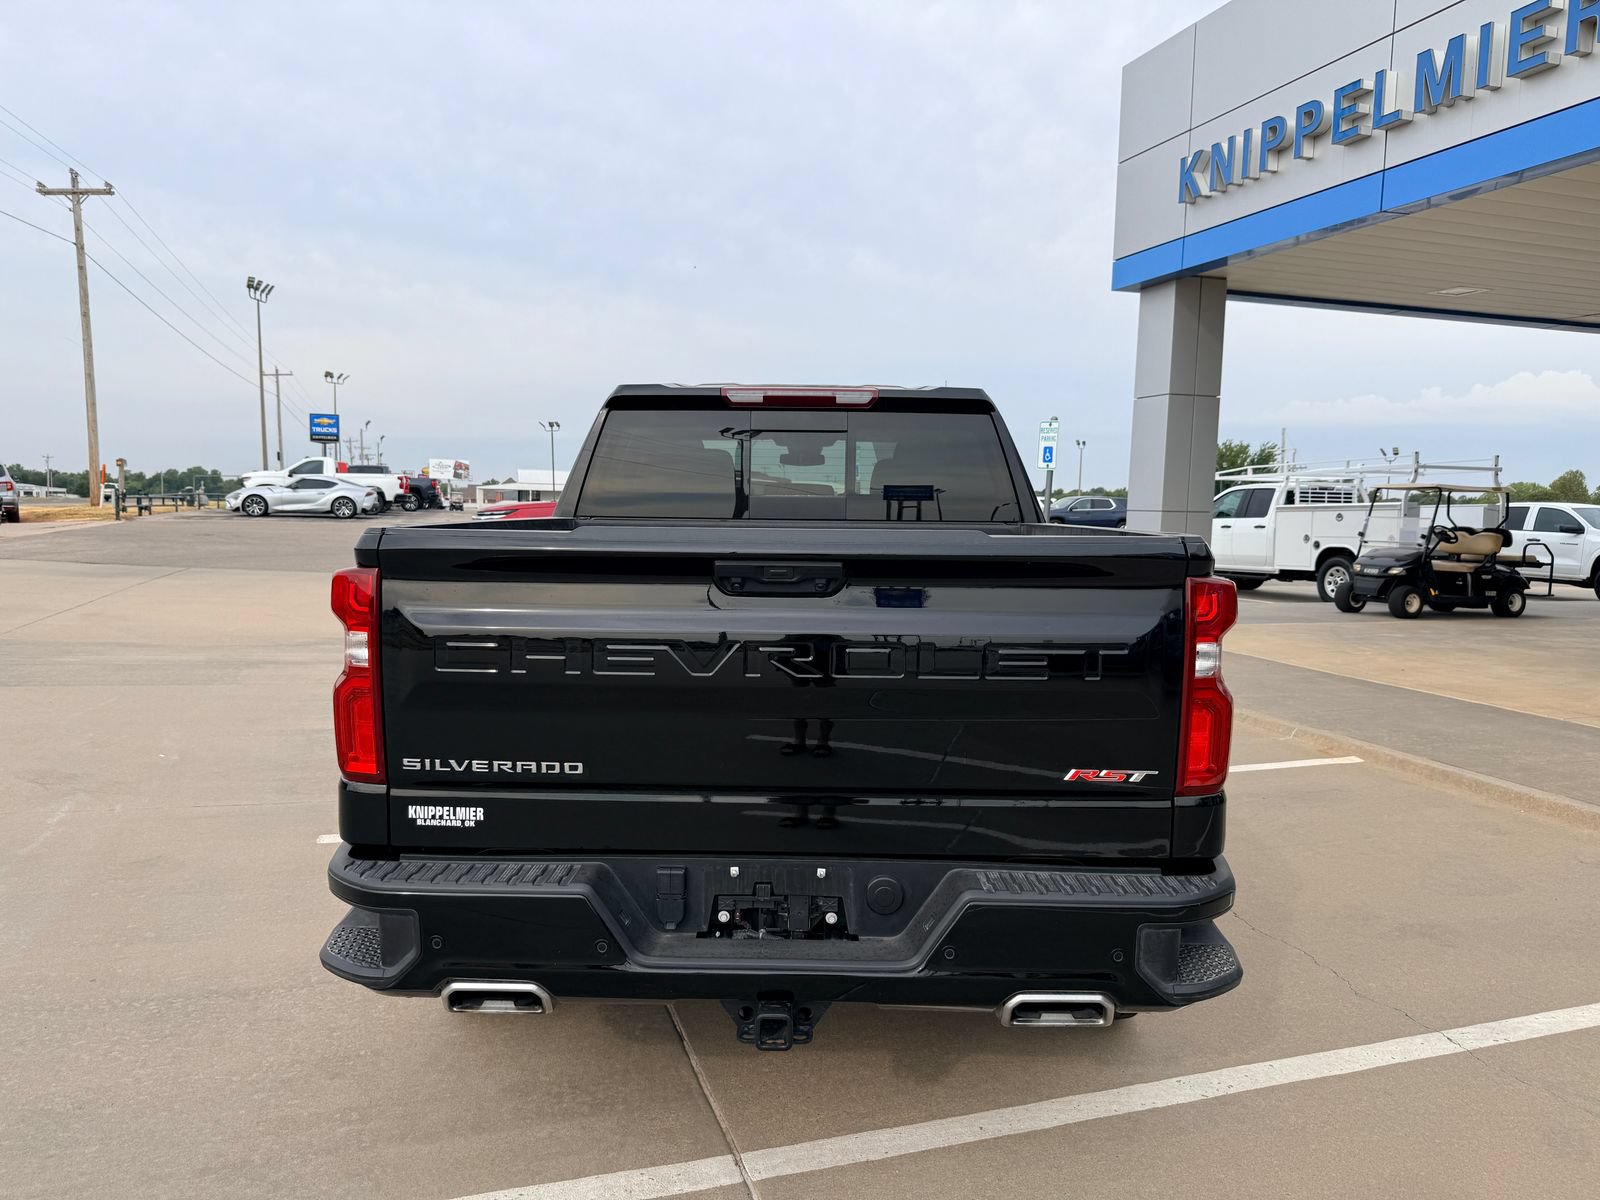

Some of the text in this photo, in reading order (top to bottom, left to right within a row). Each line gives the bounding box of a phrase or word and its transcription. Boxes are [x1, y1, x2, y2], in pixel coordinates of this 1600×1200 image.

[1178, 0, 1600, 204] KNIPPELMIER
[433, 637, 1129, 681] CHEVROLET
[402, 758, 584, 774] SILVERADO
[1063, 768, 1159, 782] RST
[408, 805, 484, 820] KNIPPELMIER
[416, 818, 463, 828] BLANCHARD,
